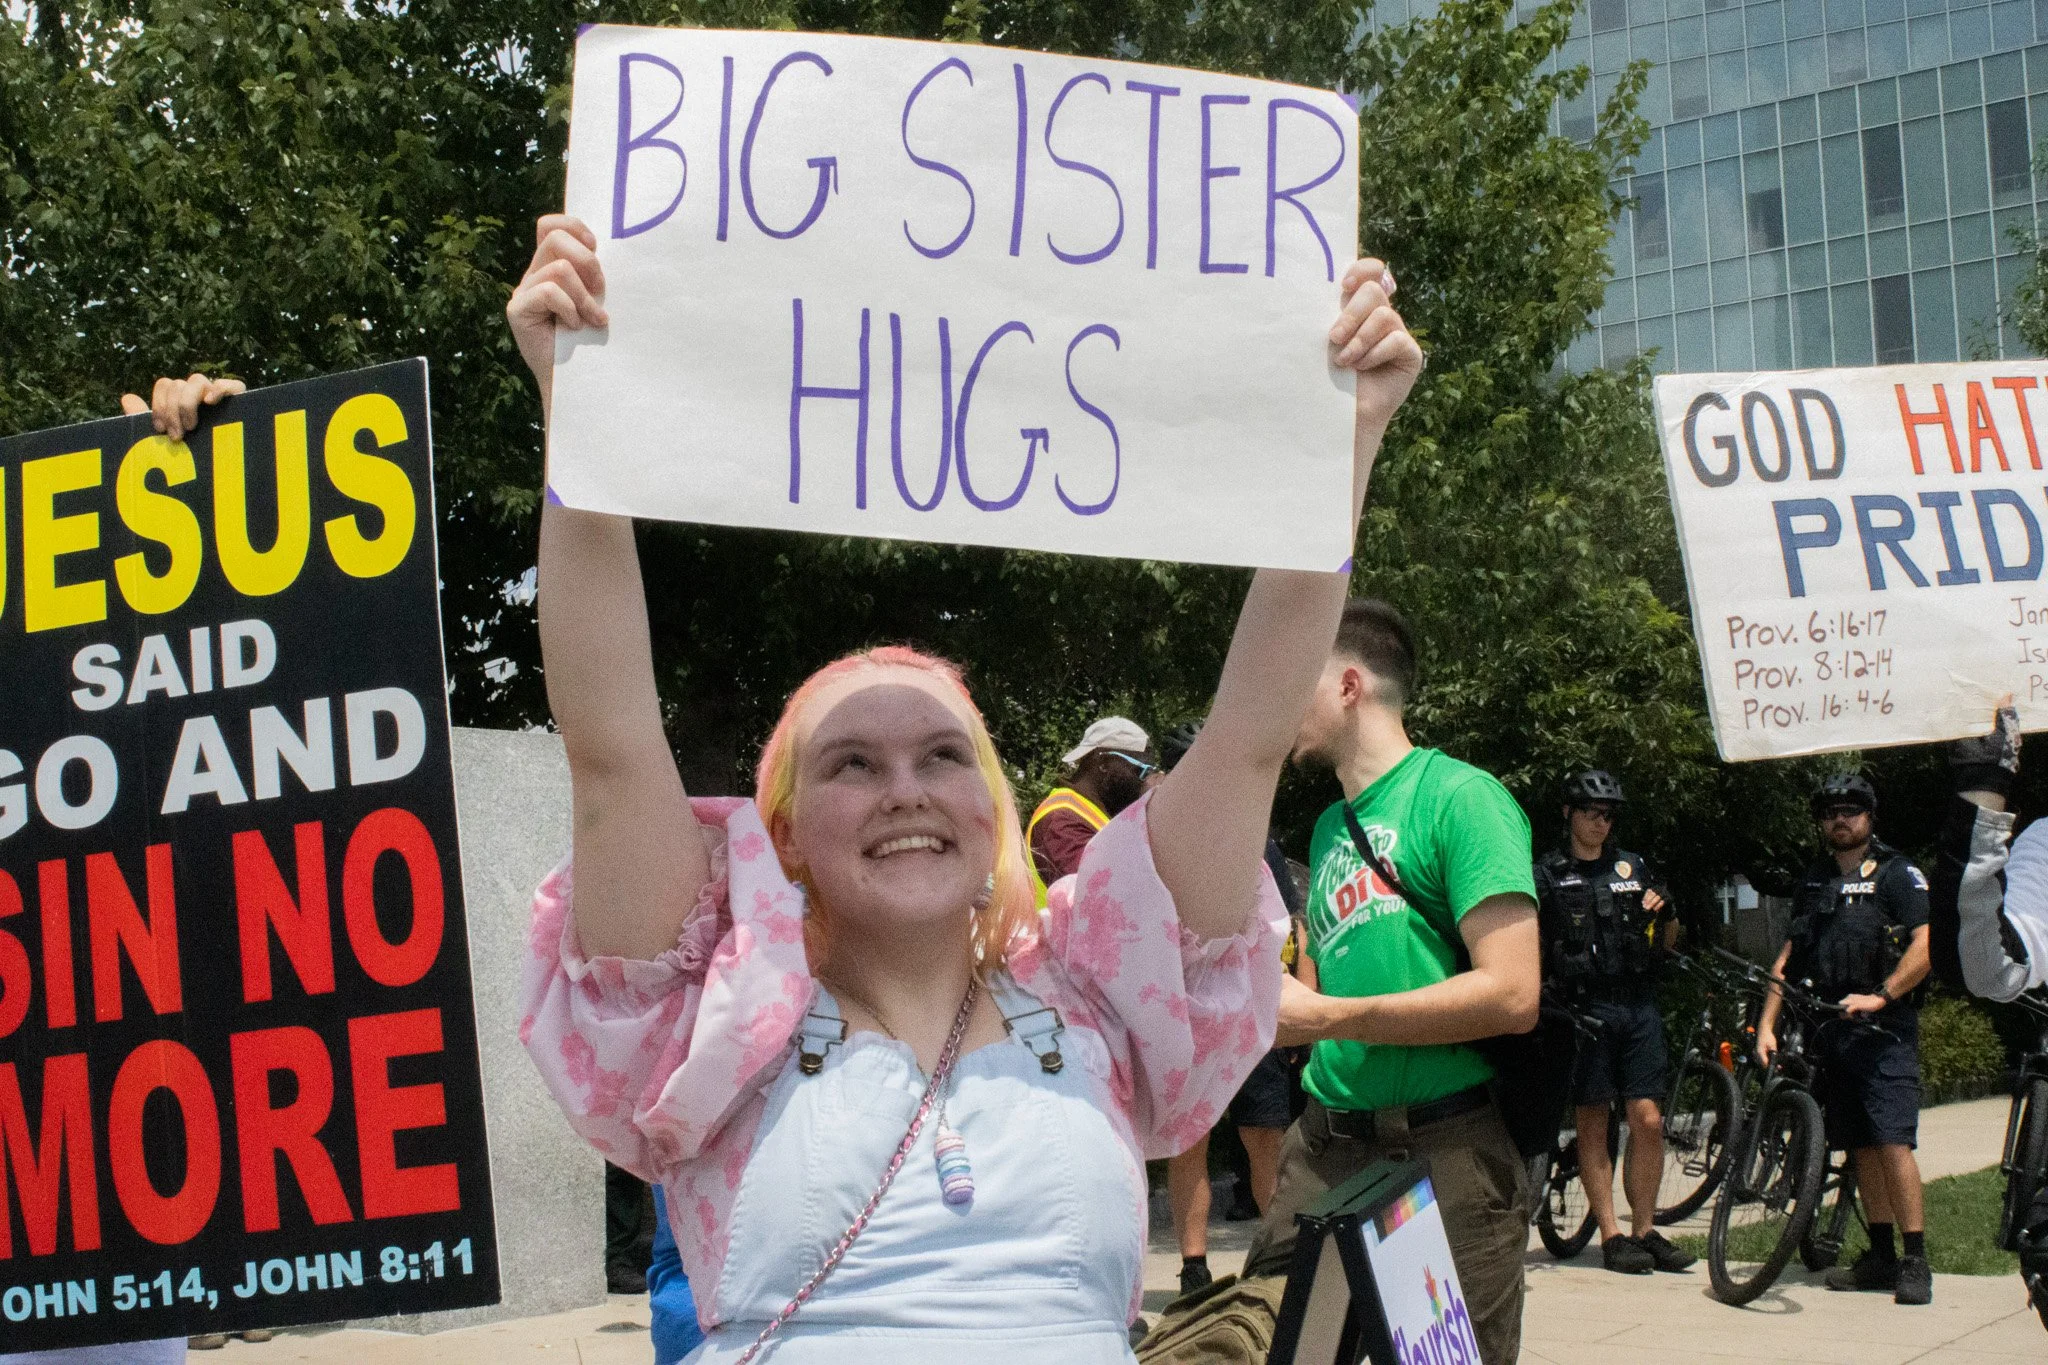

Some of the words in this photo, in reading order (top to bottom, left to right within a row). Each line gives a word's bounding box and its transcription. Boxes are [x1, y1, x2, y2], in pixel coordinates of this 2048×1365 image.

[611, 51, 839, 242] BIG
[901, 56, 1347, 282] SISTER
[789, 298, 1122, 516] HUGS
[1682, 388, 1846, 488] GOD
[1894, 375, 2048, 475] HAT
[0, 393, 417, 633] ESUS
[1772, 486, 2048, 598] PRID
[71, 618, 277, 712] SAID
[1727, 615, 1798, 649] Prov.
[1734, 659, 1802, 690] Prov.
[2017, 638, 2048, 664] Is
[161, 687, 426, 815] AND
[1743, 698, 1809, 730] Prov.
[232, 807, 445, 1004] NO
[1609, 881, 1642, 892] POLICE
[1842, 882, 1876, 894] POLICE
[0, 1007, 461, 1260] MORE
[0, 1279, 97, 1322] OHN
[113, 1267, 218, 1310] 5:14,
[233, 1250, 364, 1298] JOHN
[380, 1238, 474, 1282] 8:11
